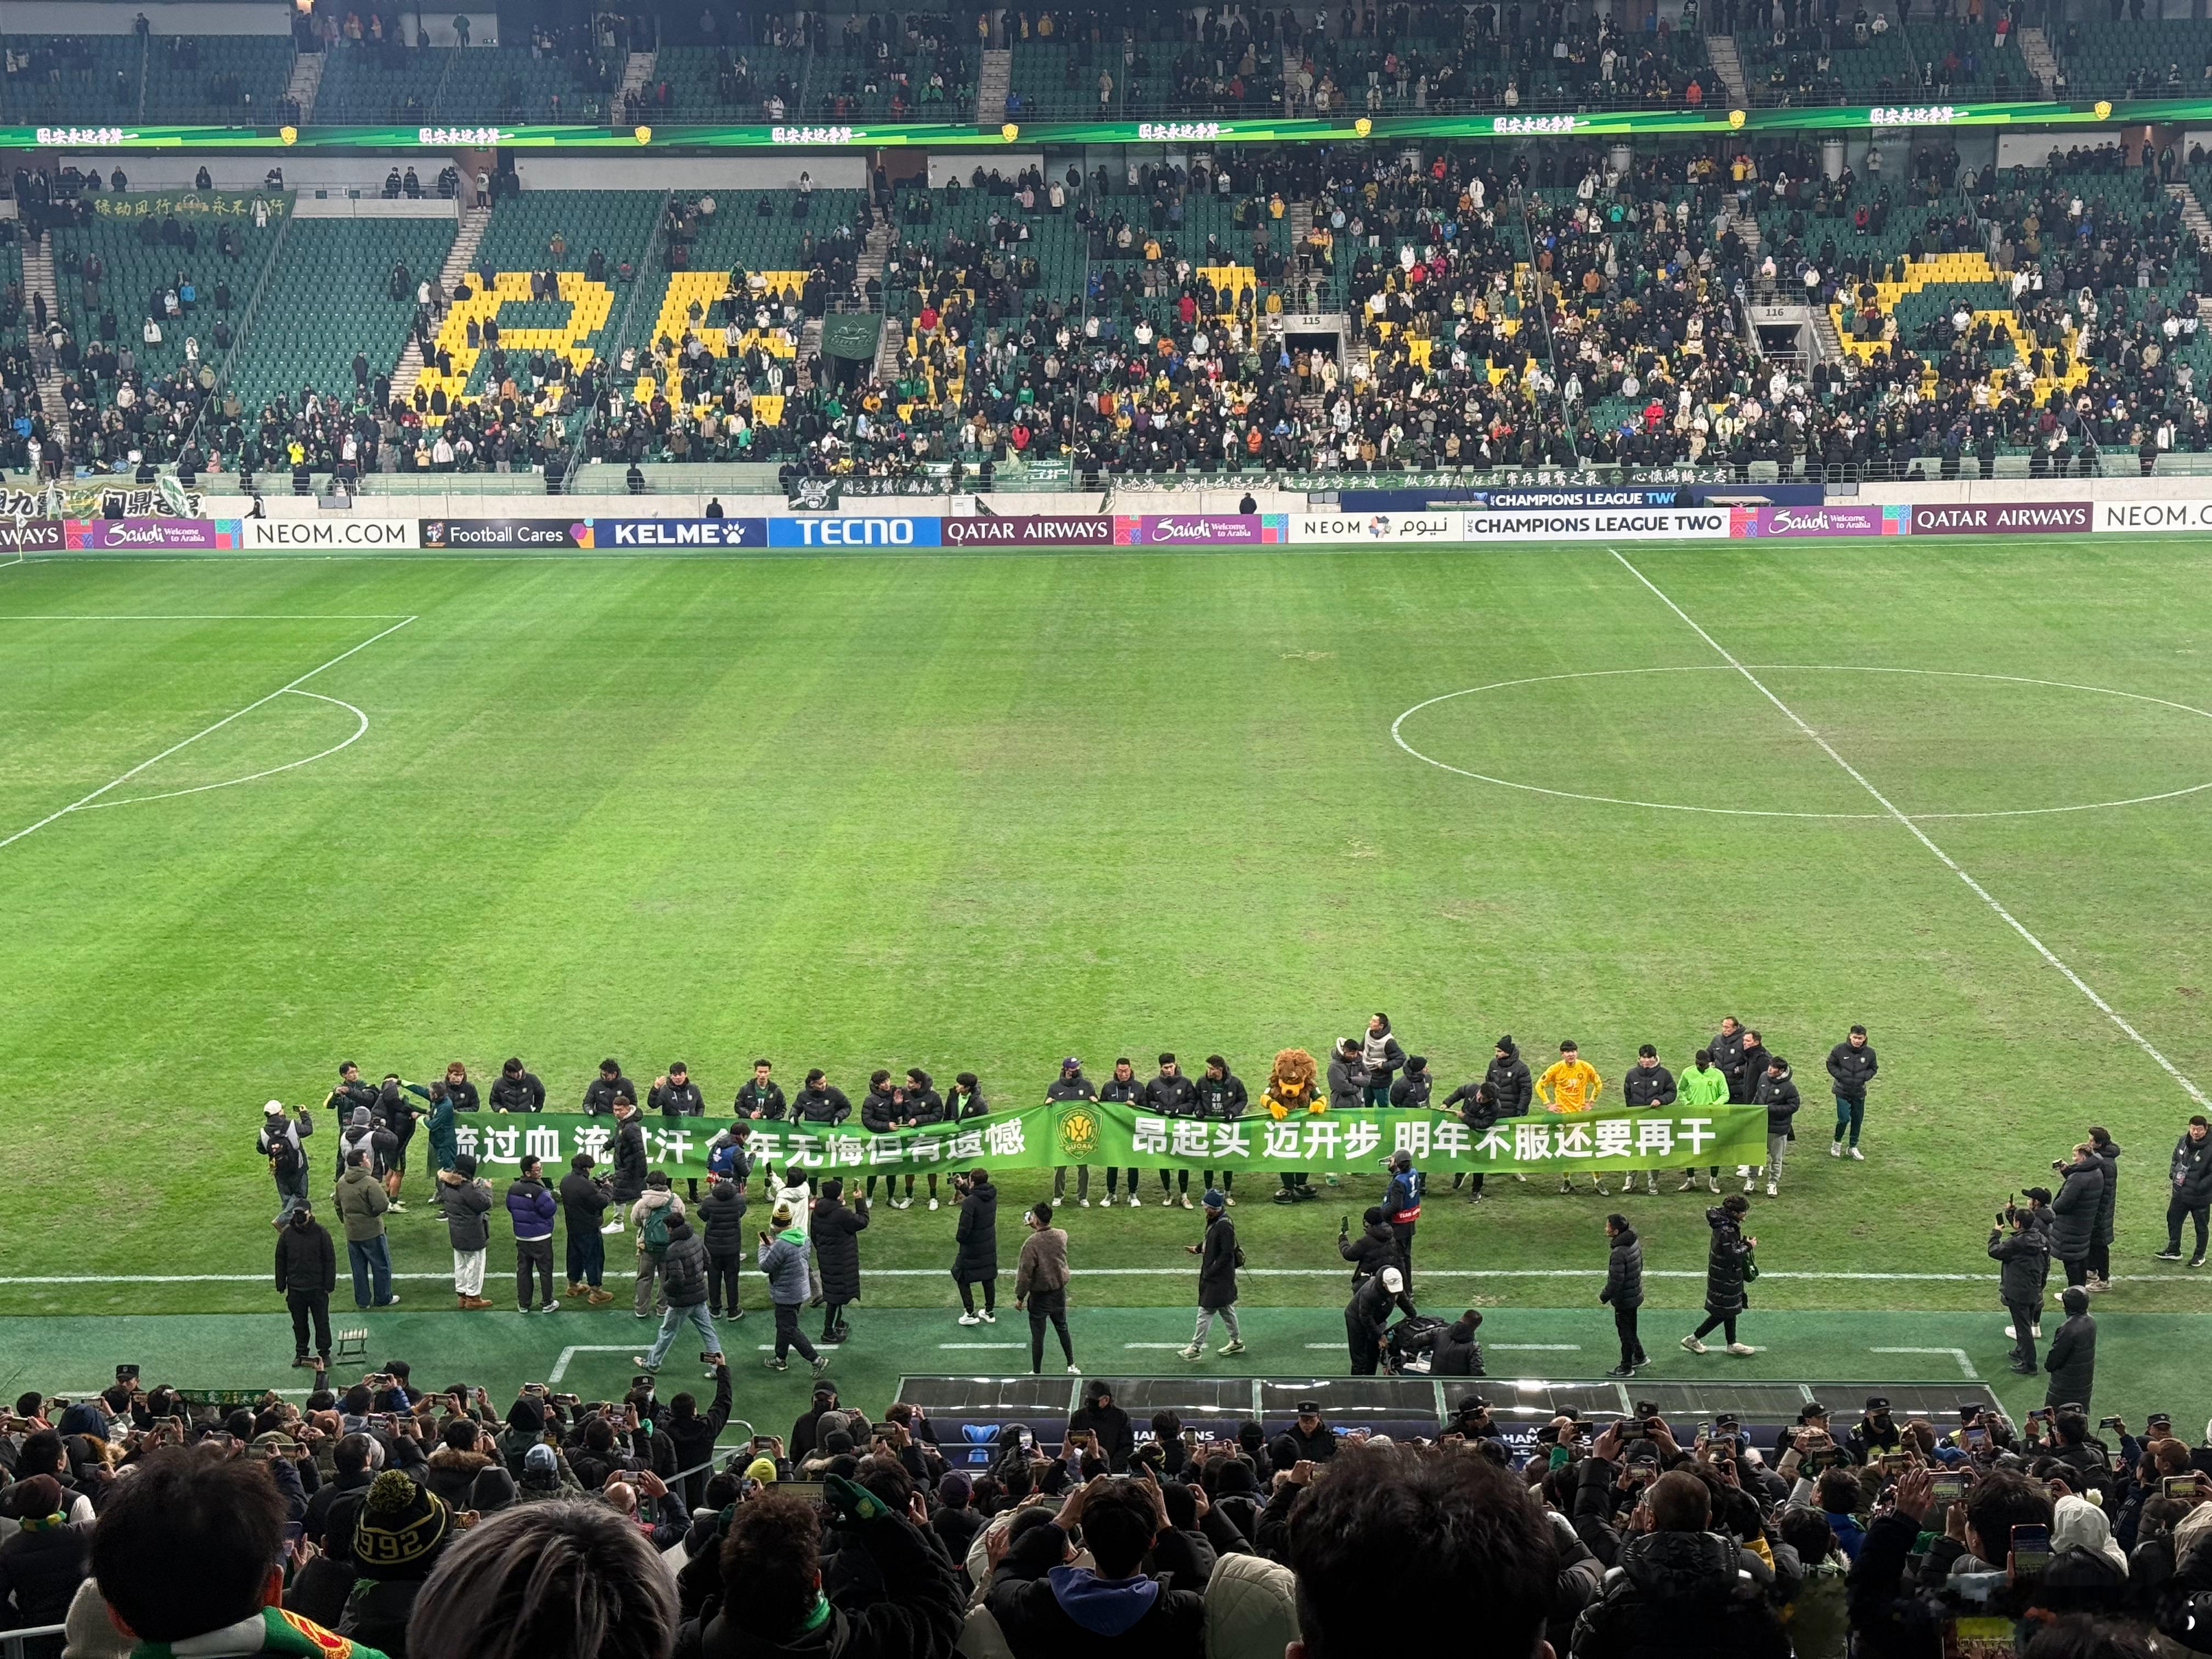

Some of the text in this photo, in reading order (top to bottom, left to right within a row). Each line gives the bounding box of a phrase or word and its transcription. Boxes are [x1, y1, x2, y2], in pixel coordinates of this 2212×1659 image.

[212, 195, 285, 215] 永不行
[1302, 317, 1321, 325] 115
[1766, 308, 1784, 317] 116
[1496, 493, 1583, 506] CHAMPIONS
[1587, 492, 1643, 505] LEAGUE
[1305, 520, 1361, 534] NEOM
[1400, 517, 1447, 536] نيوم
[1475, 517, 1590, 533] CHAMPIONS
[1595, 516, 1669, 532] LEAGUE
[1917, 508, 2086, 528] QATAR AIRWAYS
[0, 527, 59, 546] WAYS
[164, 527, 199, 535] Welcome
[256, 524, 405, 544] NEOM.COM
[450, 526, 563, 542] Football Cares
[615, 524, 720, 544] KELME
[795, 519, 913, 545] TECNO
[947, 522, 1108, 540] QATAR AIRWAYS
[455, 1124, 562, 1164] 流过血
[573, 1124, 695, 1164] 流汗
[1132, 1116, 1250, 1159] 昂起头
[1263, 1119, 1381, 1160] 迈开步
[1395, 1118, 1716, 1161] 明年不服还要再干
